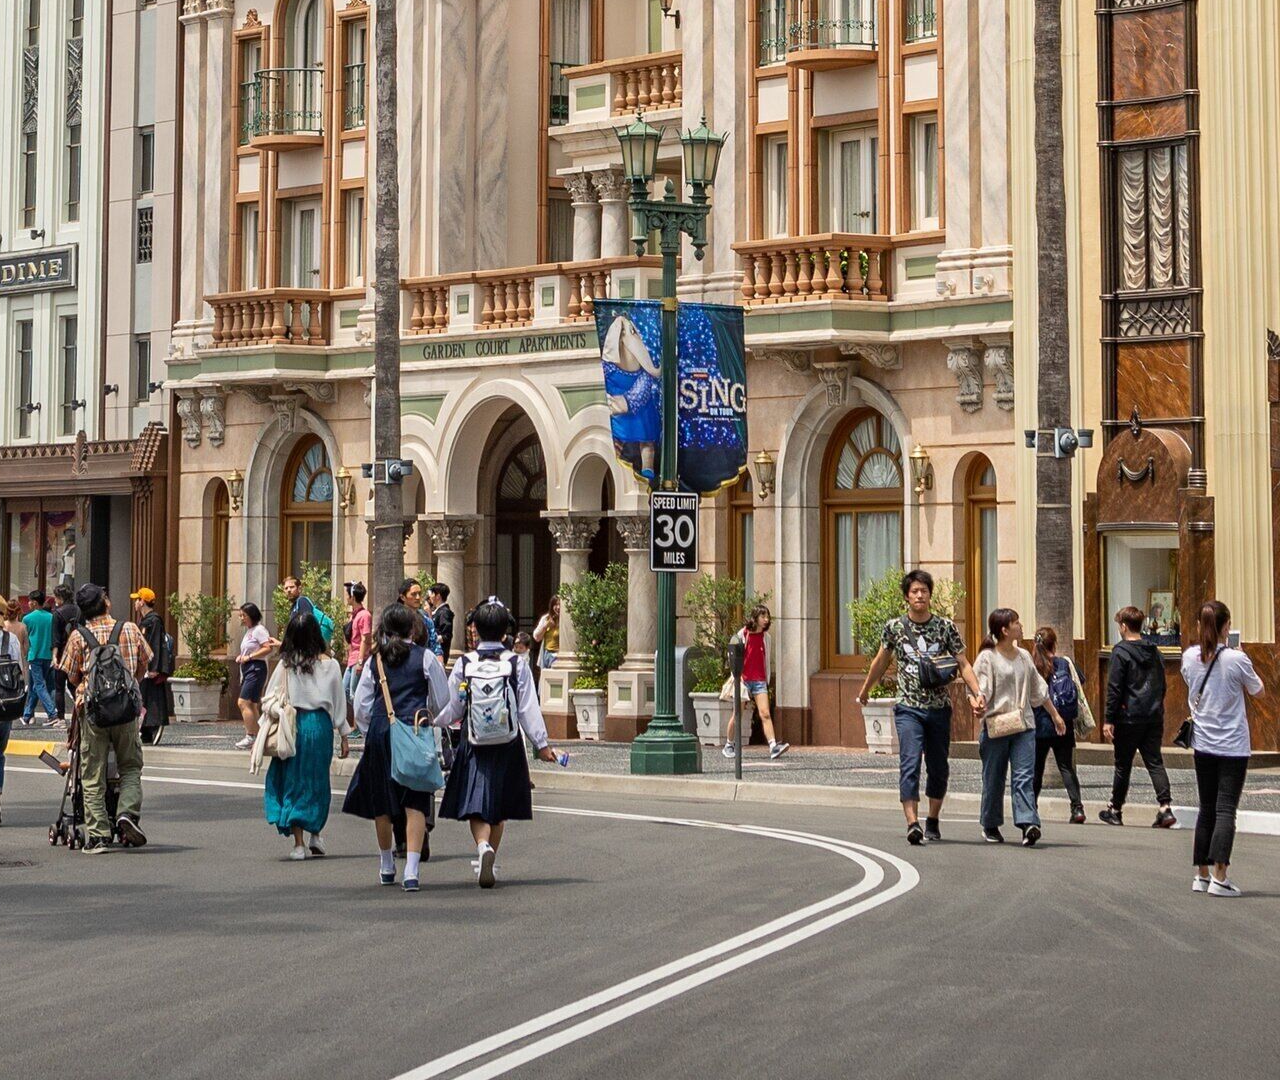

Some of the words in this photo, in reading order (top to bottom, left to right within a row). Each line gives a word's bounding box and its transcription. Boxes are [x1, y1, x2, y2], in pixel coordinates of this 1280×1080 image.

[1, 258, 63, 284] DIME
[423, 342, 466, 360] GARDEN
[475, 339, 510, 357] COURT
[518, 333, 586, 353] APARTMENTS
[679, 376, 747, 413] SING
[653, 497, 675, 509] SPEED
[677, 498, 696, 510] LIMIT
[655, 514, 694, 548] 30
[663, 552, 685, 565] MILES
